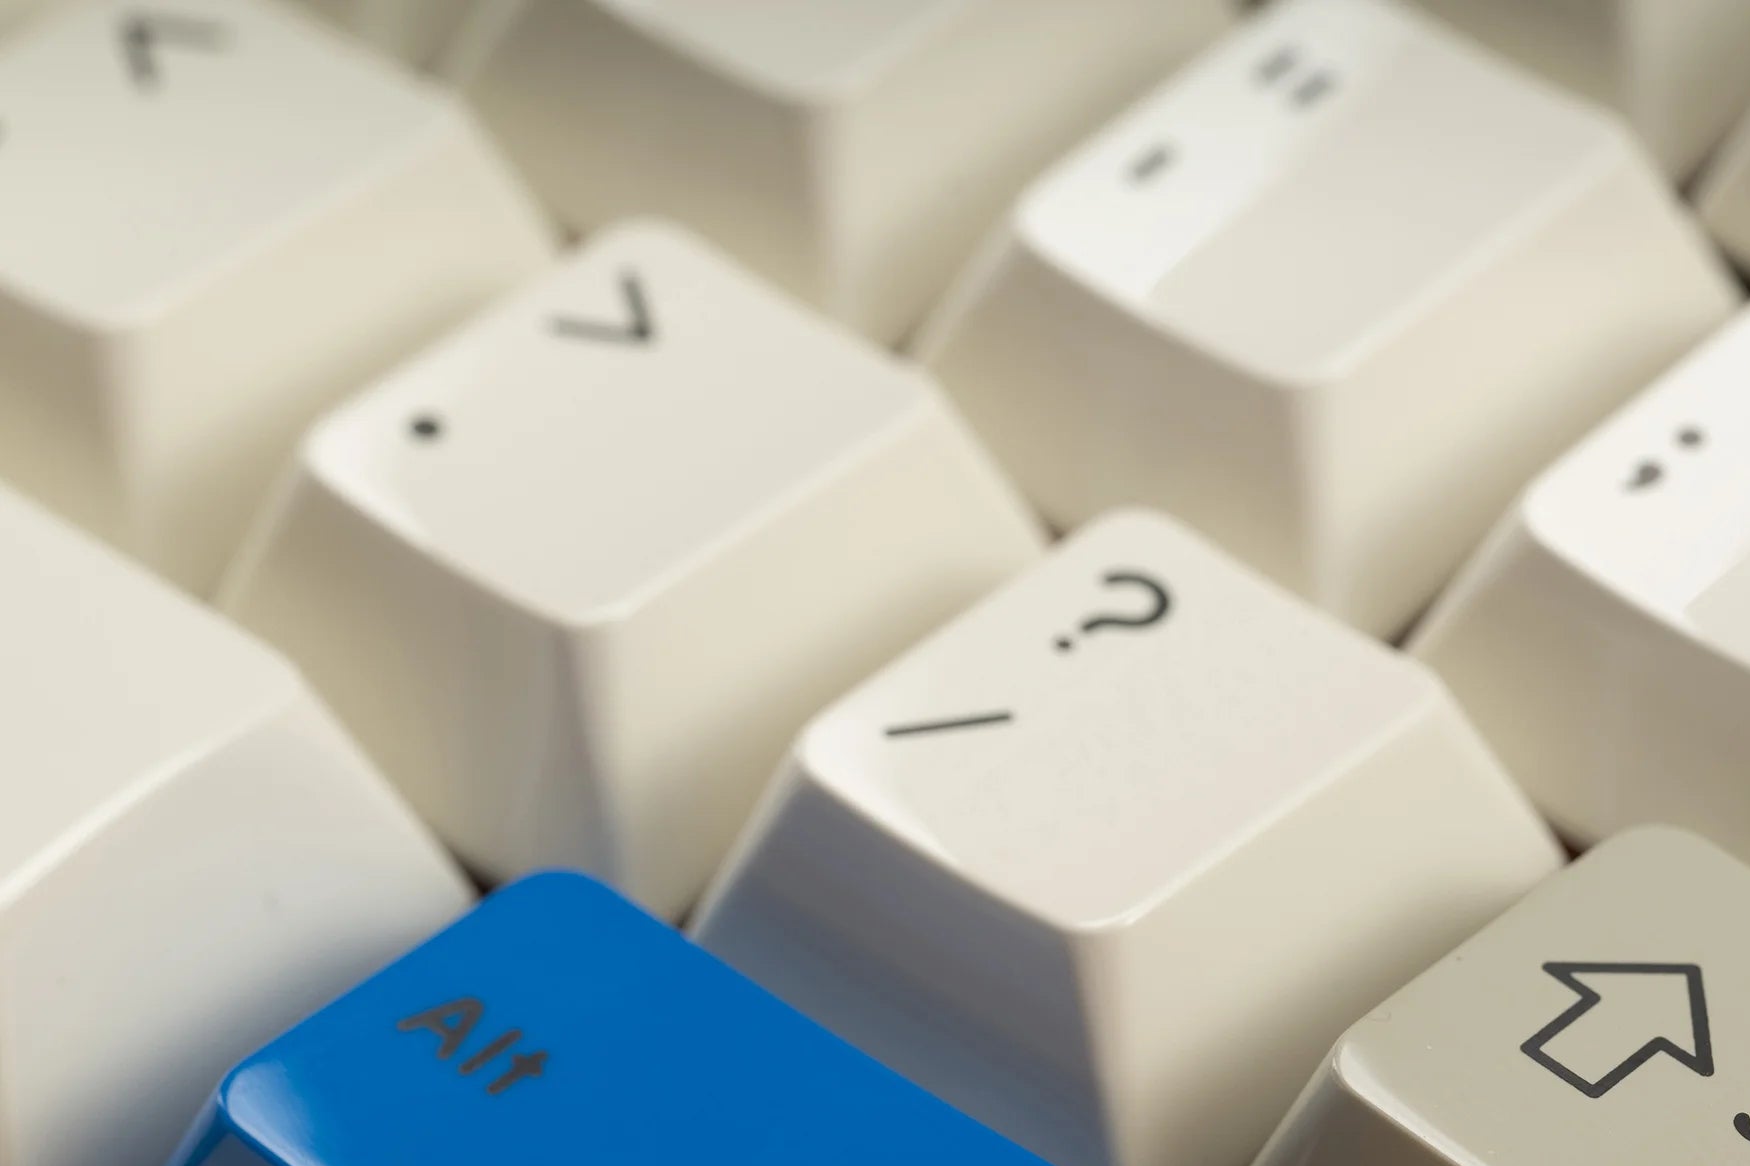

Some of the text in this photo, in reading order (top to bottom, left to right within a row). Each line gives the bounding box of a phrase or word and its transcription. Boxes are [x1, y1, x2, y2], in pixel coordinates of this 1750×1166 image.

[1053, 570, 1173, 653] ?
[883, 710, 1015, 739] /
[396, 996, 549, 1097] Alt
